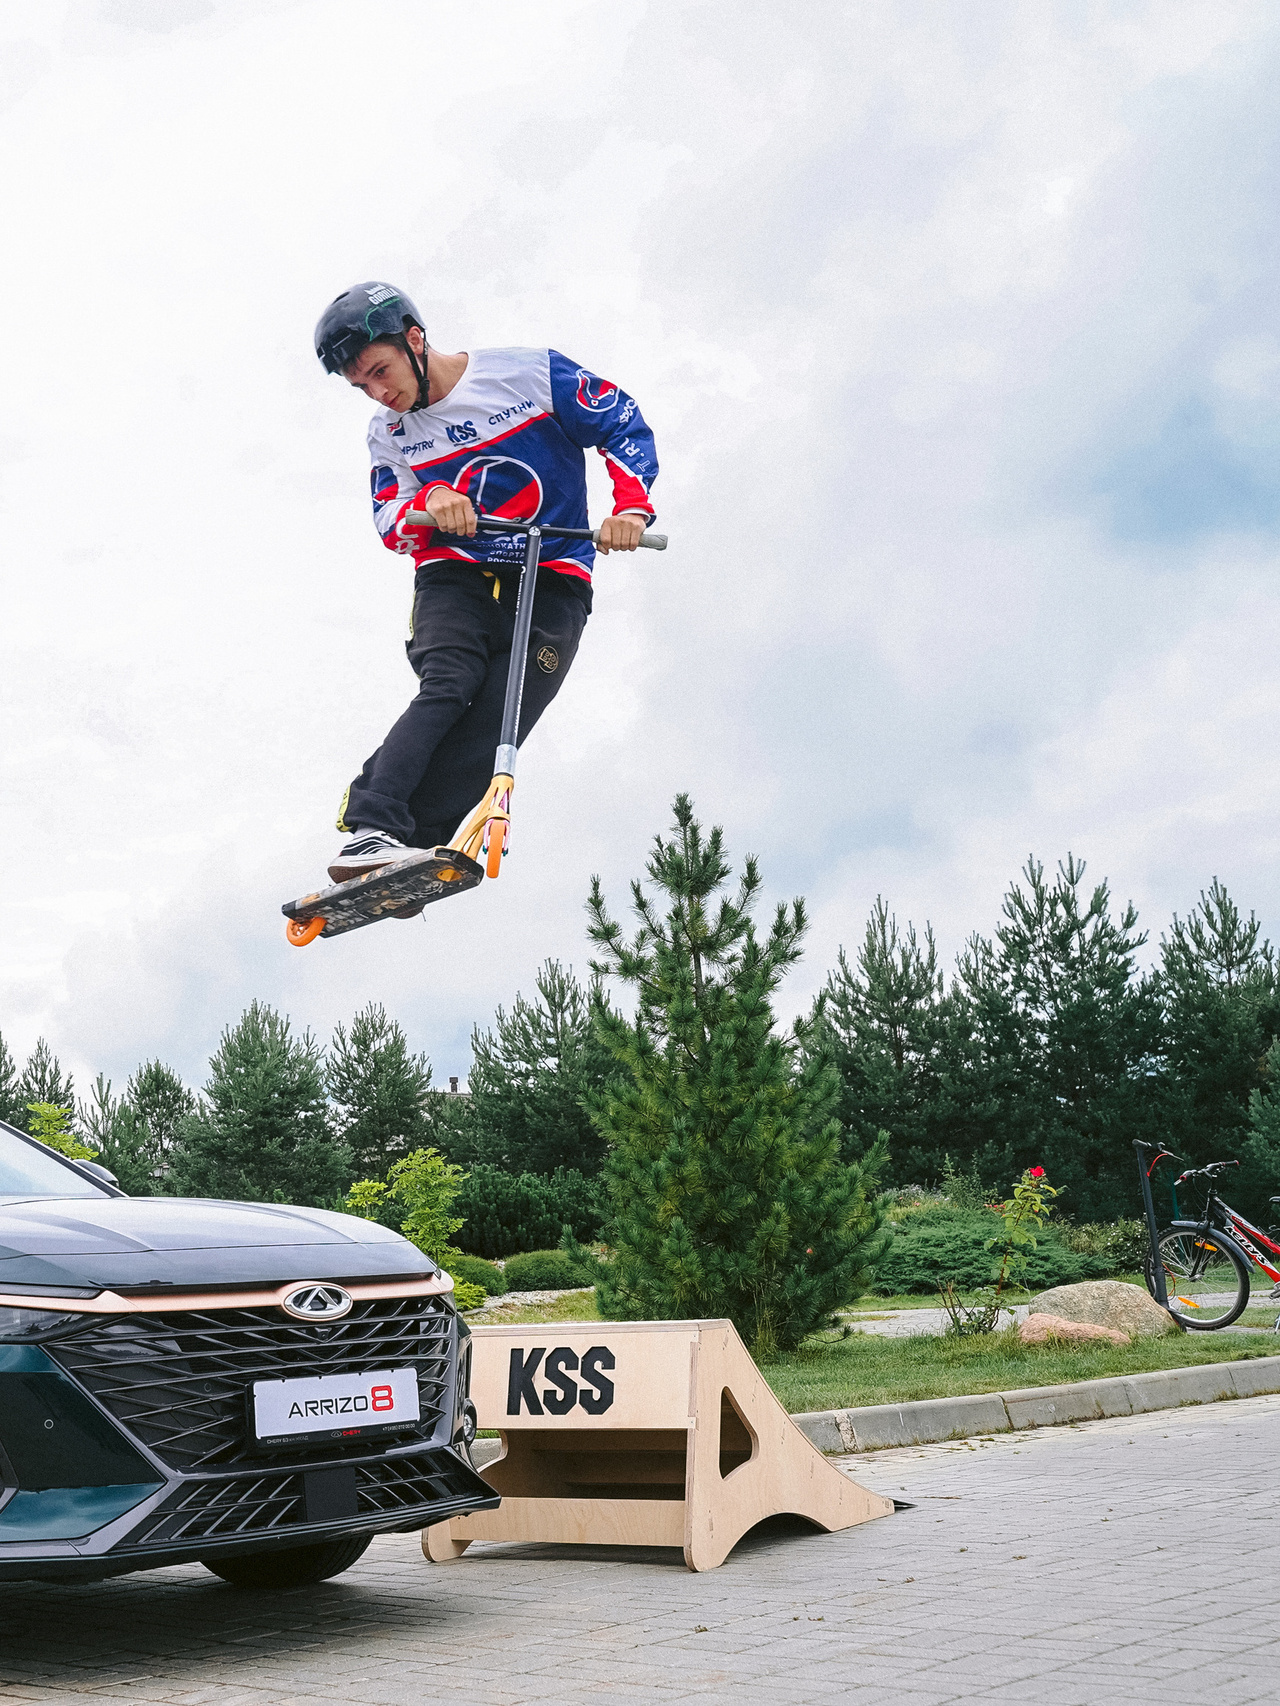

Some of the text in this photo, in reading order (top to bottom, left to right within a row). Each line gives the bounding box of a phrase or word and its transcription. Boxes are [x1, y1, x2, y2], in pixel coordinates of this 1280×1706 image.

[488, 400, 535, 426] СПУТНИ
[445, 420, 478, 444] KSS
[506, 1346, 616, 1416] KSS
[288, 1385, 394, 1419] ARRIZO 8
